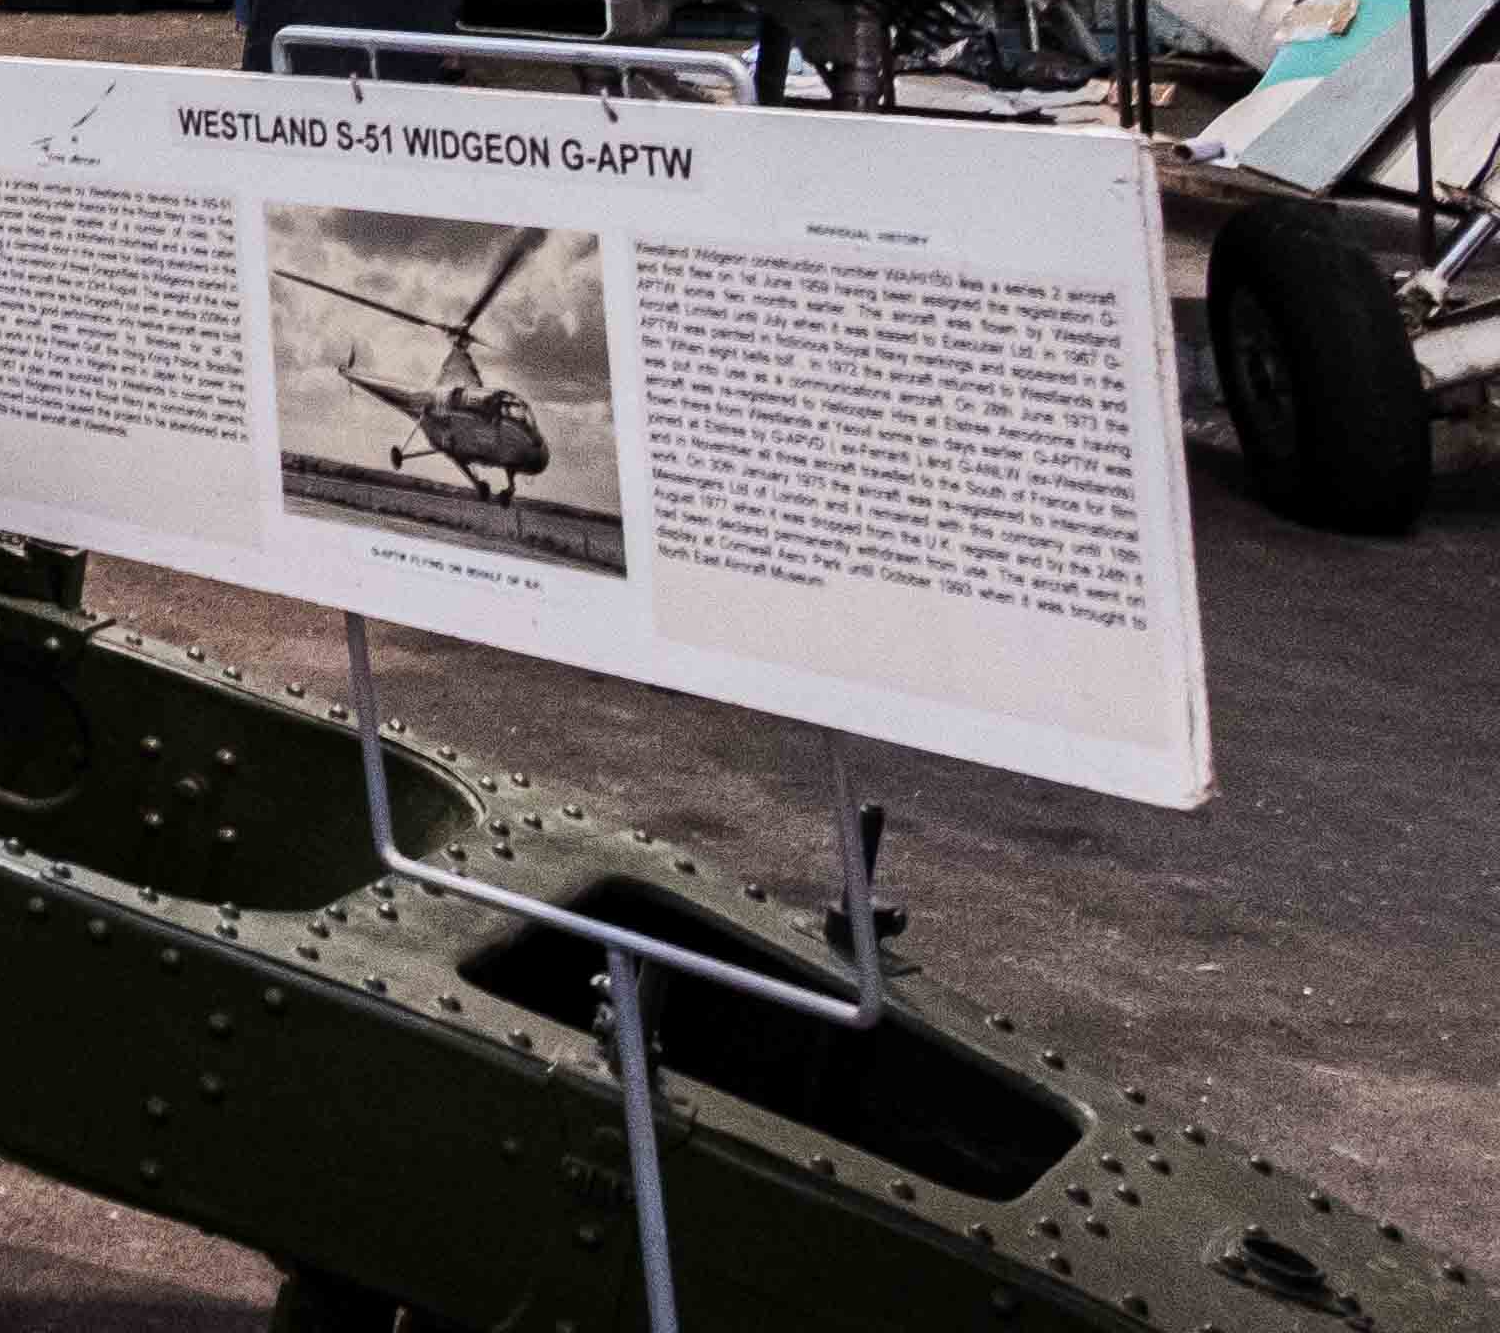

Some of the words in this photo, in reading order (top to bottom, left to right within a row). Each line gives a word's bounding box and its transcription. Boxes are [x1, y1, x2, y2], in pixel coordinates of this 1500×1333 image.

[179, 107, 327, 148] WESTLAND
[336, 120, 392, 153] S-51
[402, 126, 550, 168] WIDGEON
[561, 138, 692, 179] G-APTW
